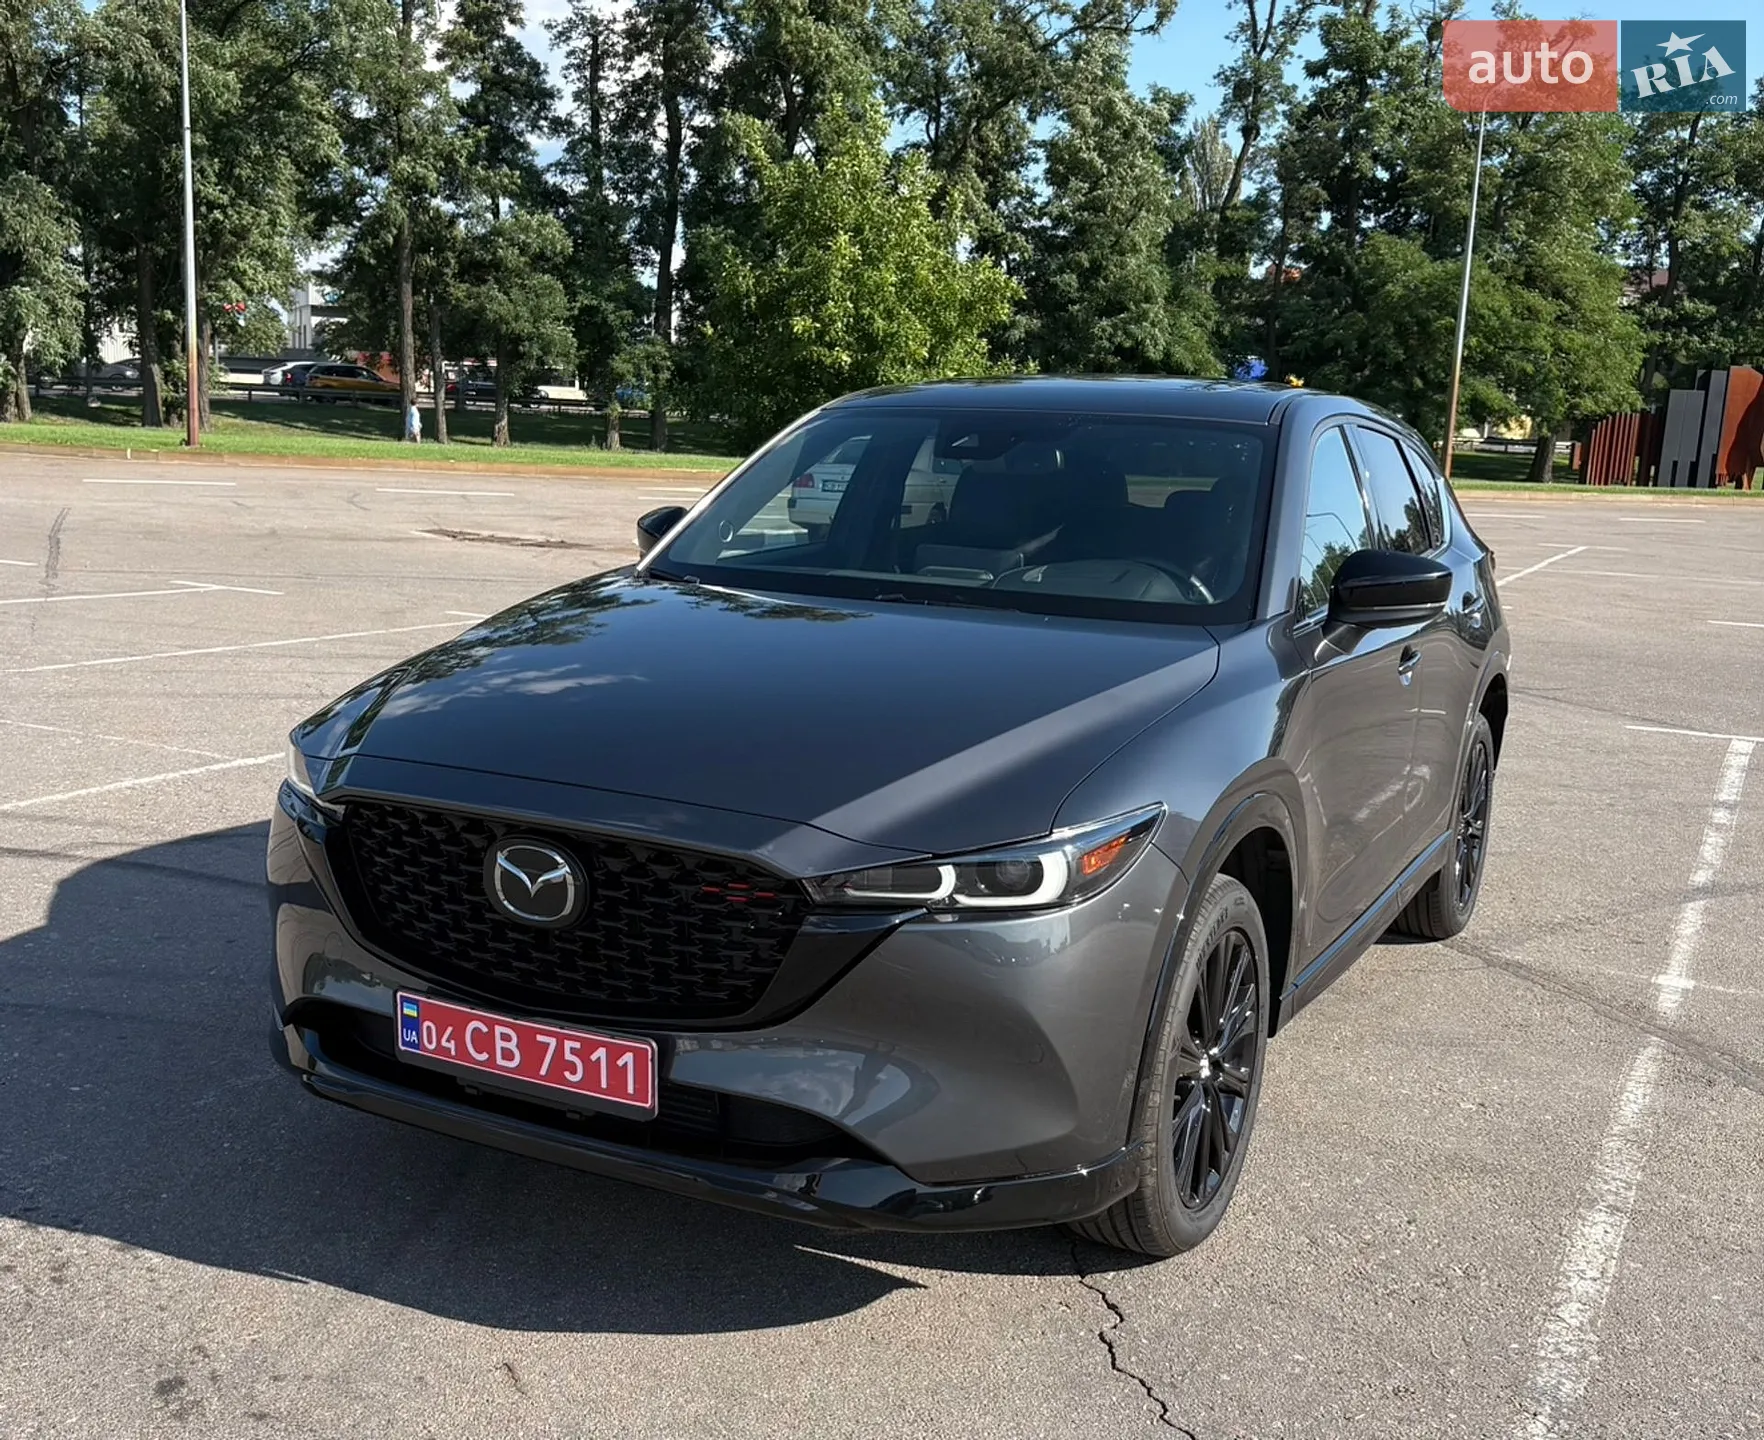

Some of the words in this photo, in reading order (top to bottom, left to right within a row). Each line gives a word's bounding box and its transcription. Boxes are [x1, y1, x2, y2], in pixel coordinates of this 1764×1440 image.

[402, 1028, 419, 1044] UA
[422, 1020, 456, 1056] 04
[464, 1020, 521, 1069] CB
[535, 1034, 635, 1095] 7511
